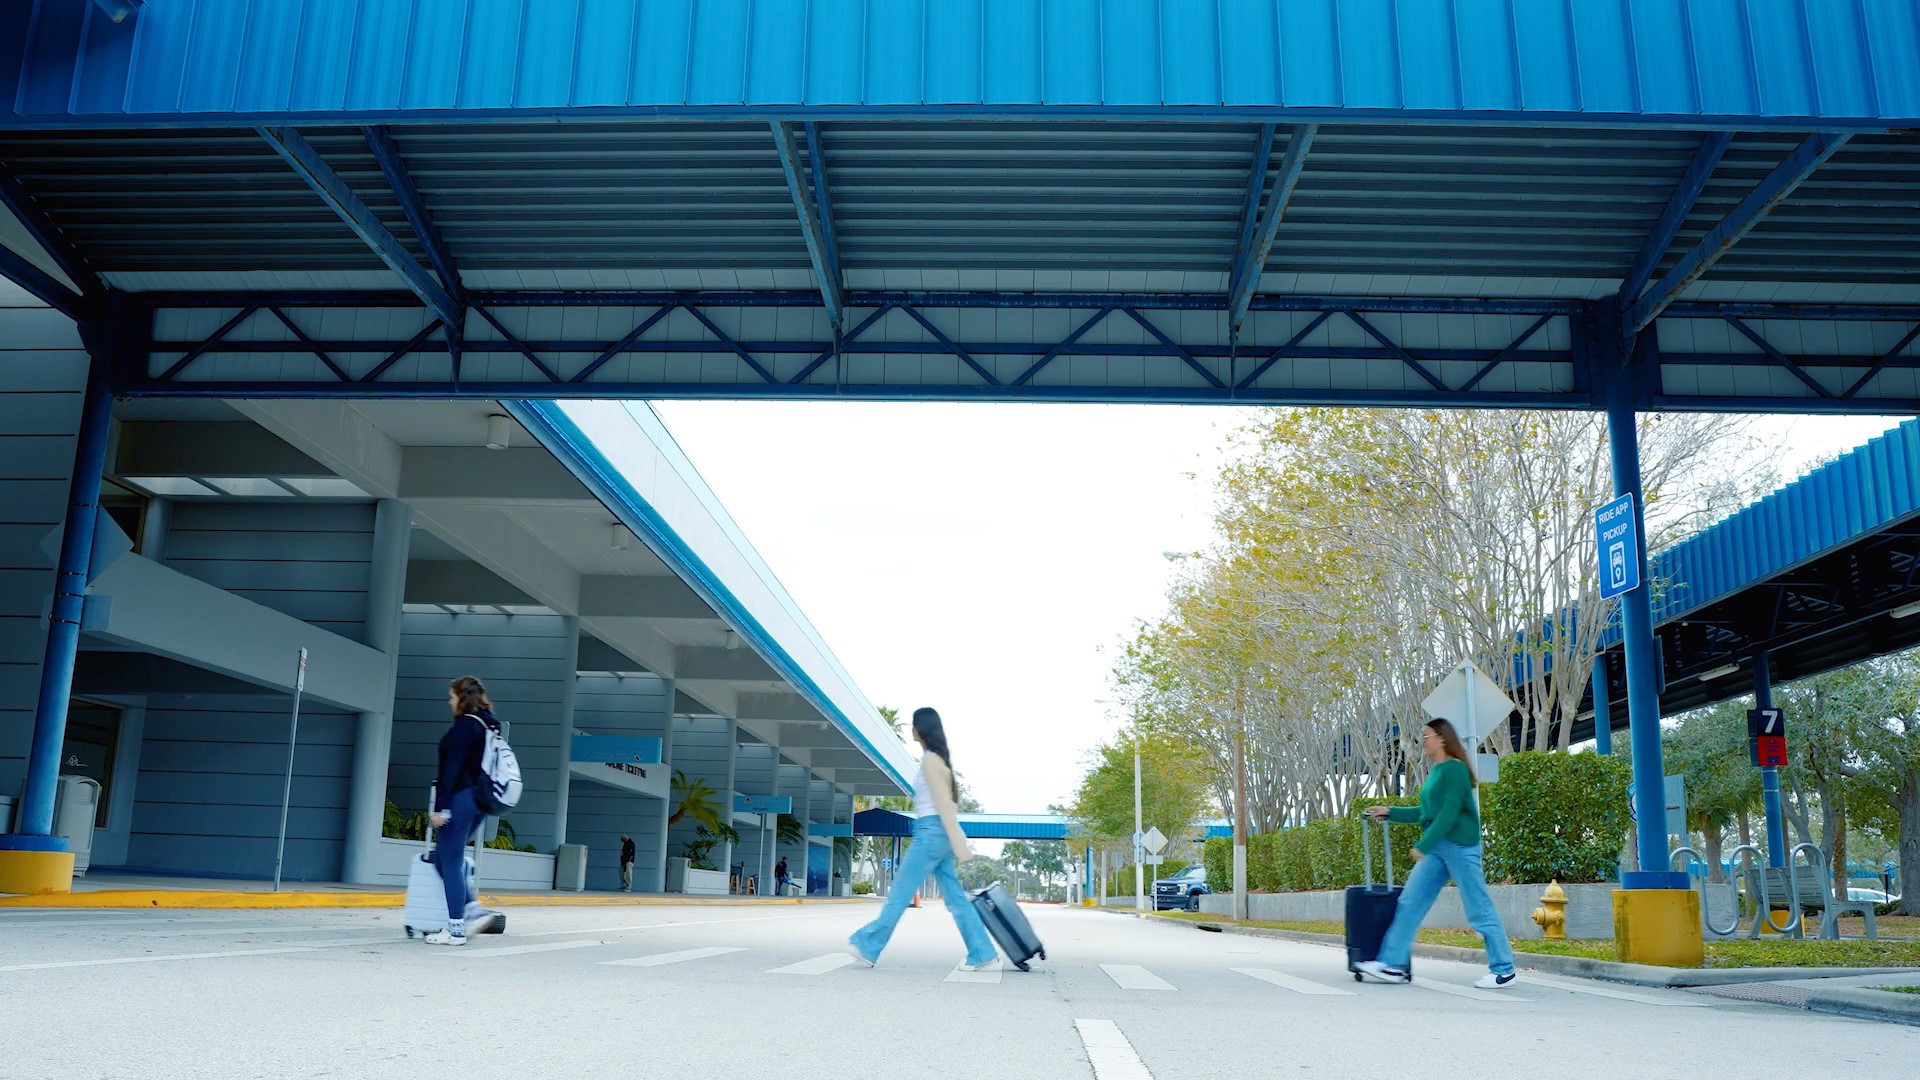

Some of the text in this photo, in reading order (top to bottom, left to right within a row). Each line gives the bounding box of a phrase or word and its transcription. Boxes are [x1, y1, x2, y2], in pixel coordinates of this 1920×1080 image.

[1598, 502, 1628, 524] RIDE APP
[1603, 523, 1628, 542] PICKUP
[1762, 710, 1778, 733] 7
